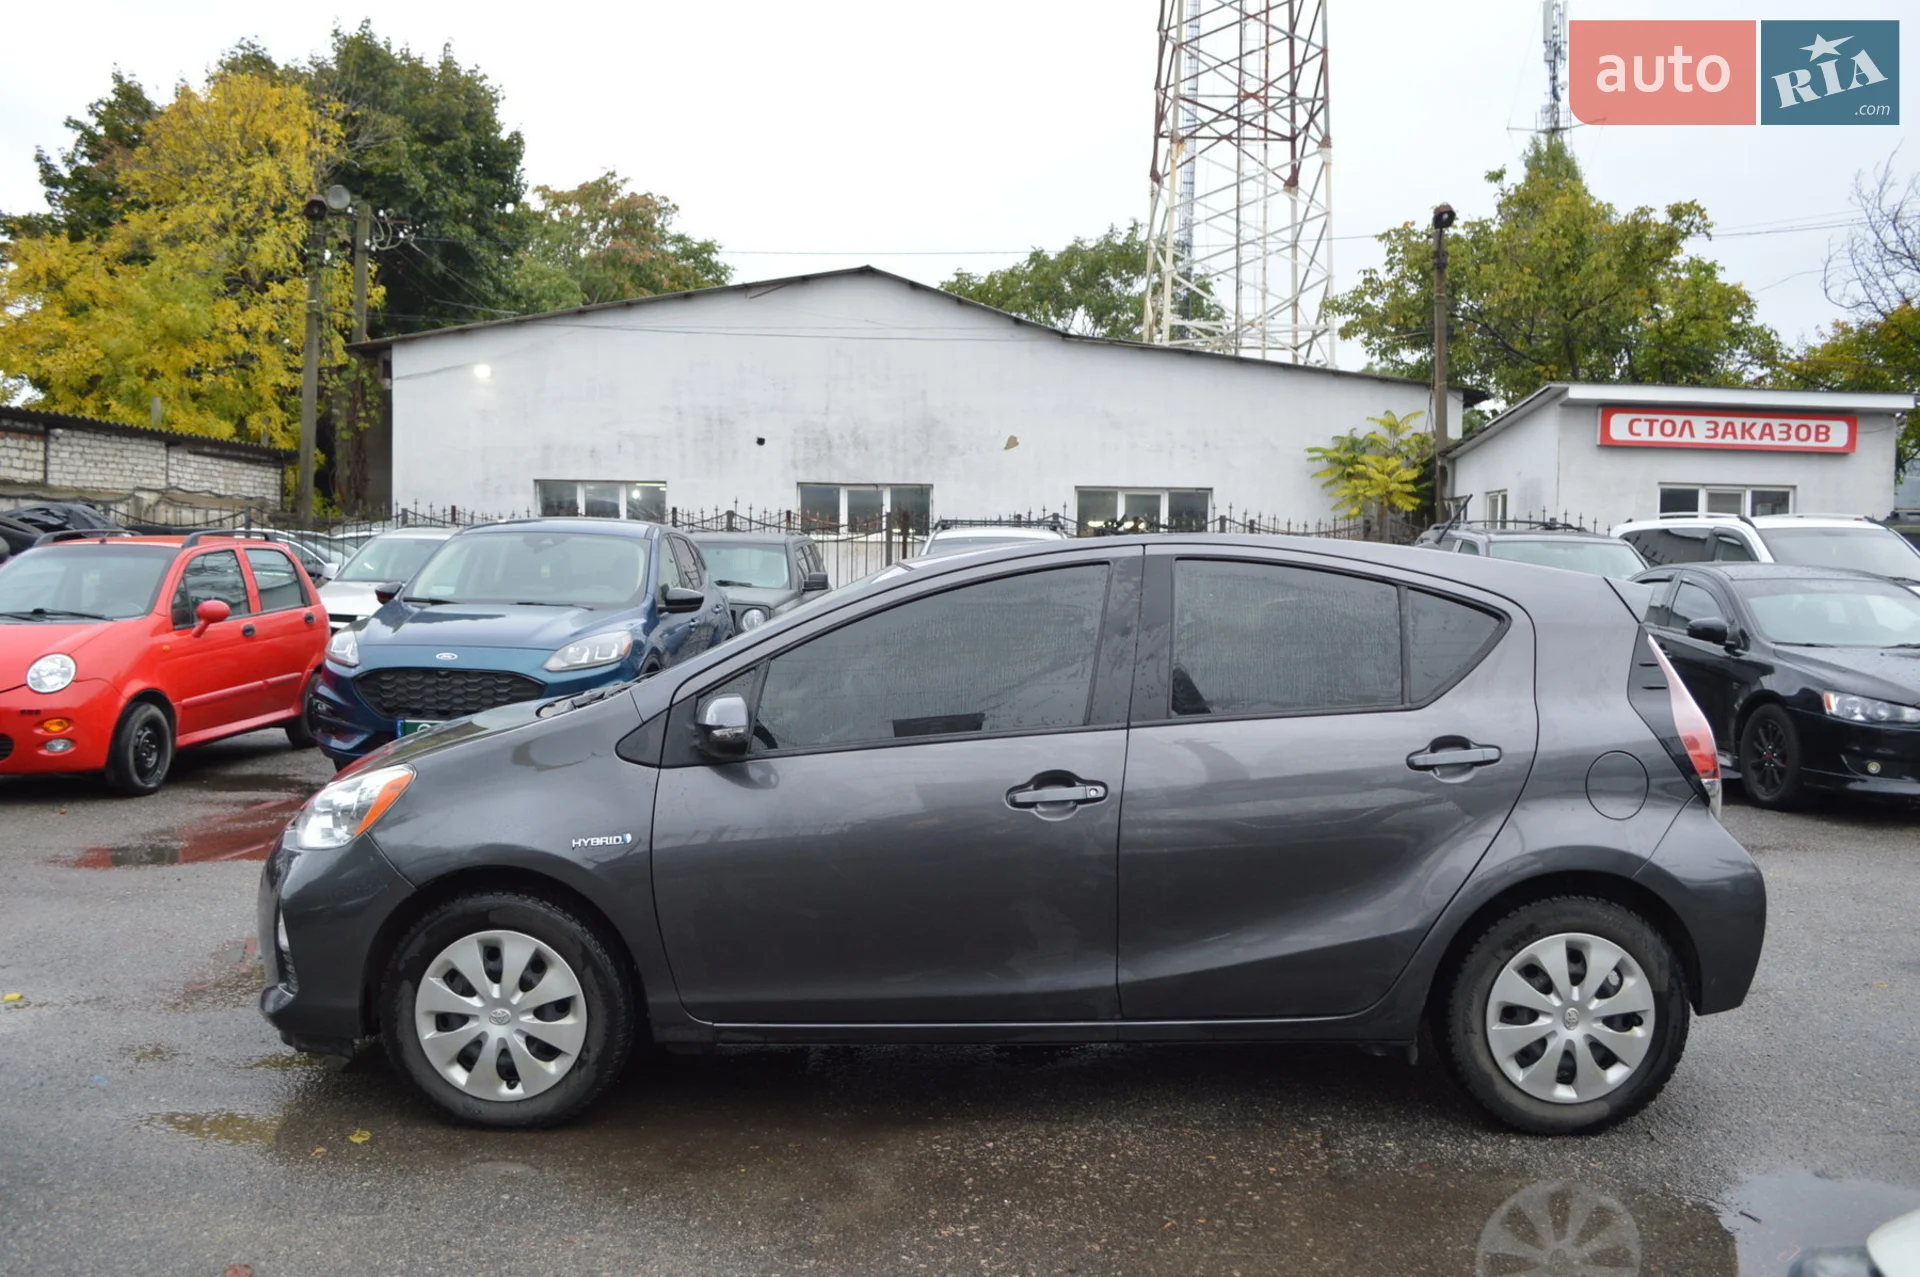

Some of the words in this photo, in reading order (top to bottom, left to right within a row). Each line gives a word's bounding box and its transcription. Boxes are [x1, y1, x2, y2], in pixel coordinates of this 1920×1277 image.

[1628, 418, 1696, 438] СТОЛ
[1705, 420, 1831, 443] ЗАКАЗОВ
[572, 835, 623, 848] HYBRID
